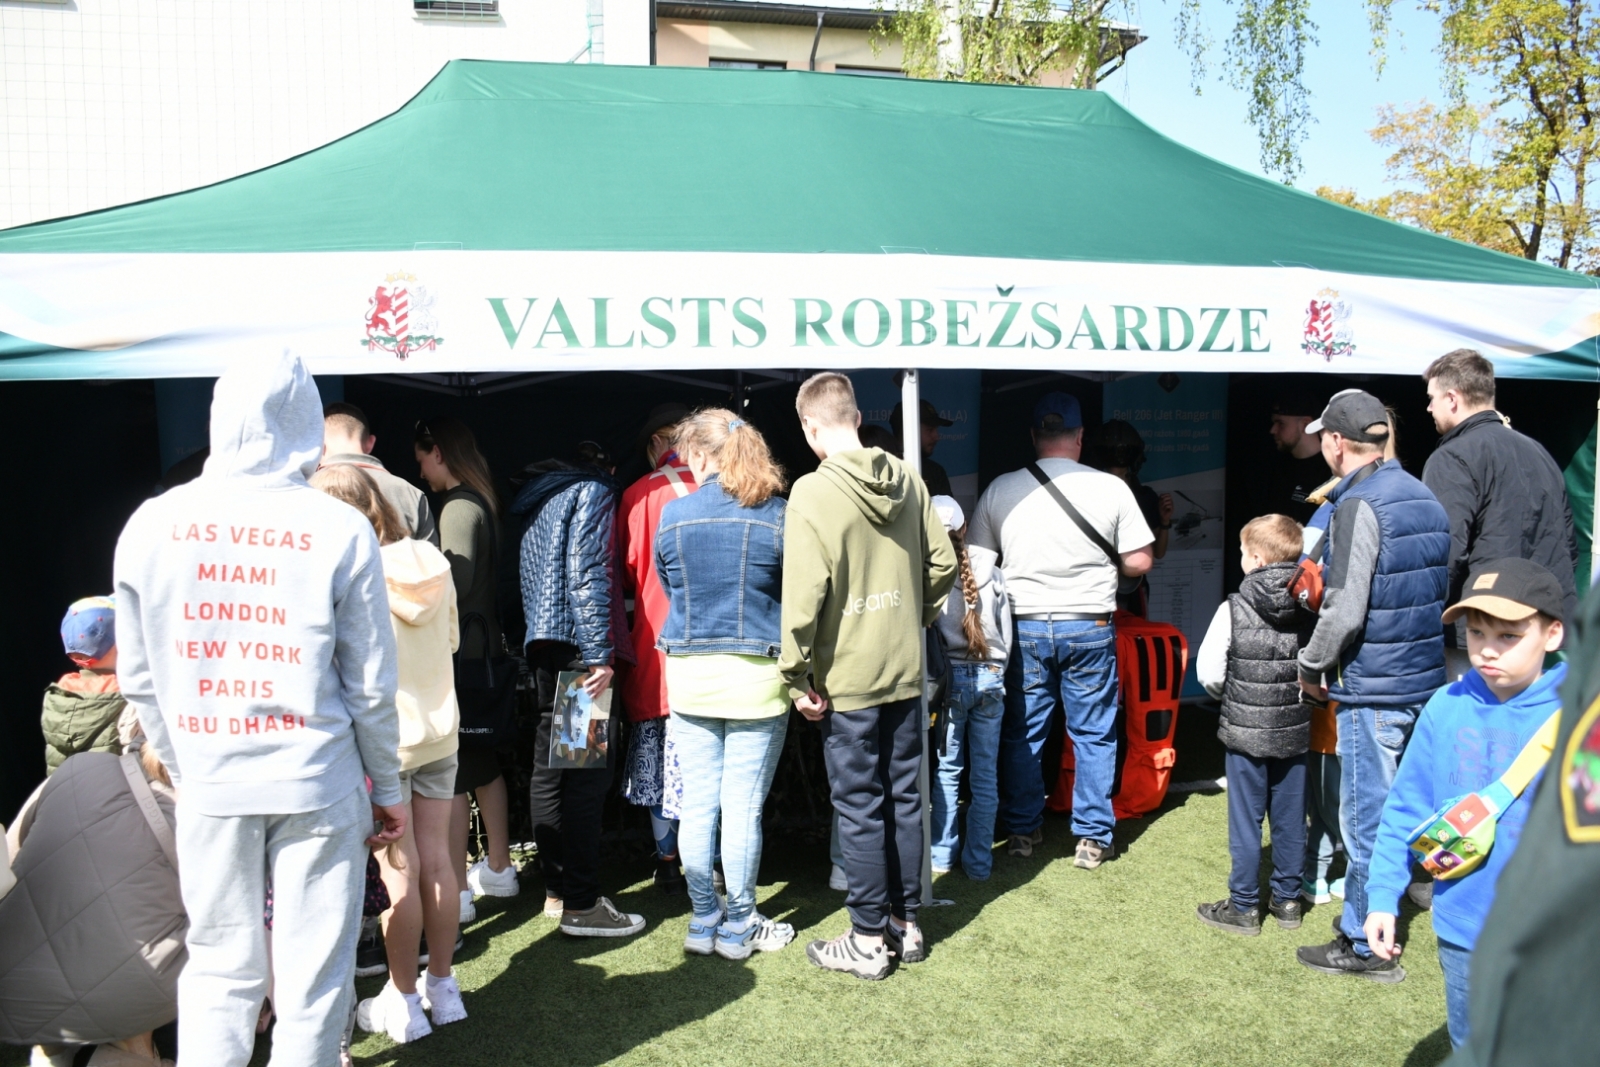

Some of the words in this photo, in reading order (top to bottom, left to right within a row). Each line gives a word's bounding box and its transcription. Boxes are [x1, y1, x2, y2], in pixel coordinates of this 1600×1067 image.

[484, 296, 767, 350] VALSTS
[789, 284, 1271, 353] ROBEŽSARDZE
[1113, 409, 1132, 421] Bell
[1134, 409, 1152, 421] 206
[1153, 409, 1173, 422] (Jet
[1175, 409, 1210, 423] Ranger
[172, 523, 218, 542] LAS
[230, 526, 313, 551] VEGAS
[197, 563, 276, 586] MIAMI
[184, 602, 286, 625] LONDON
[841, 589, 902, 616] Jeans
[175, 640, 227, 659] NEW
[238, 641, 301, 665] YORK
[199, 679, 273, 698] PARIS
[178, 714, 218, 734] ABU
[229, 714, 305, 735] DHABI
